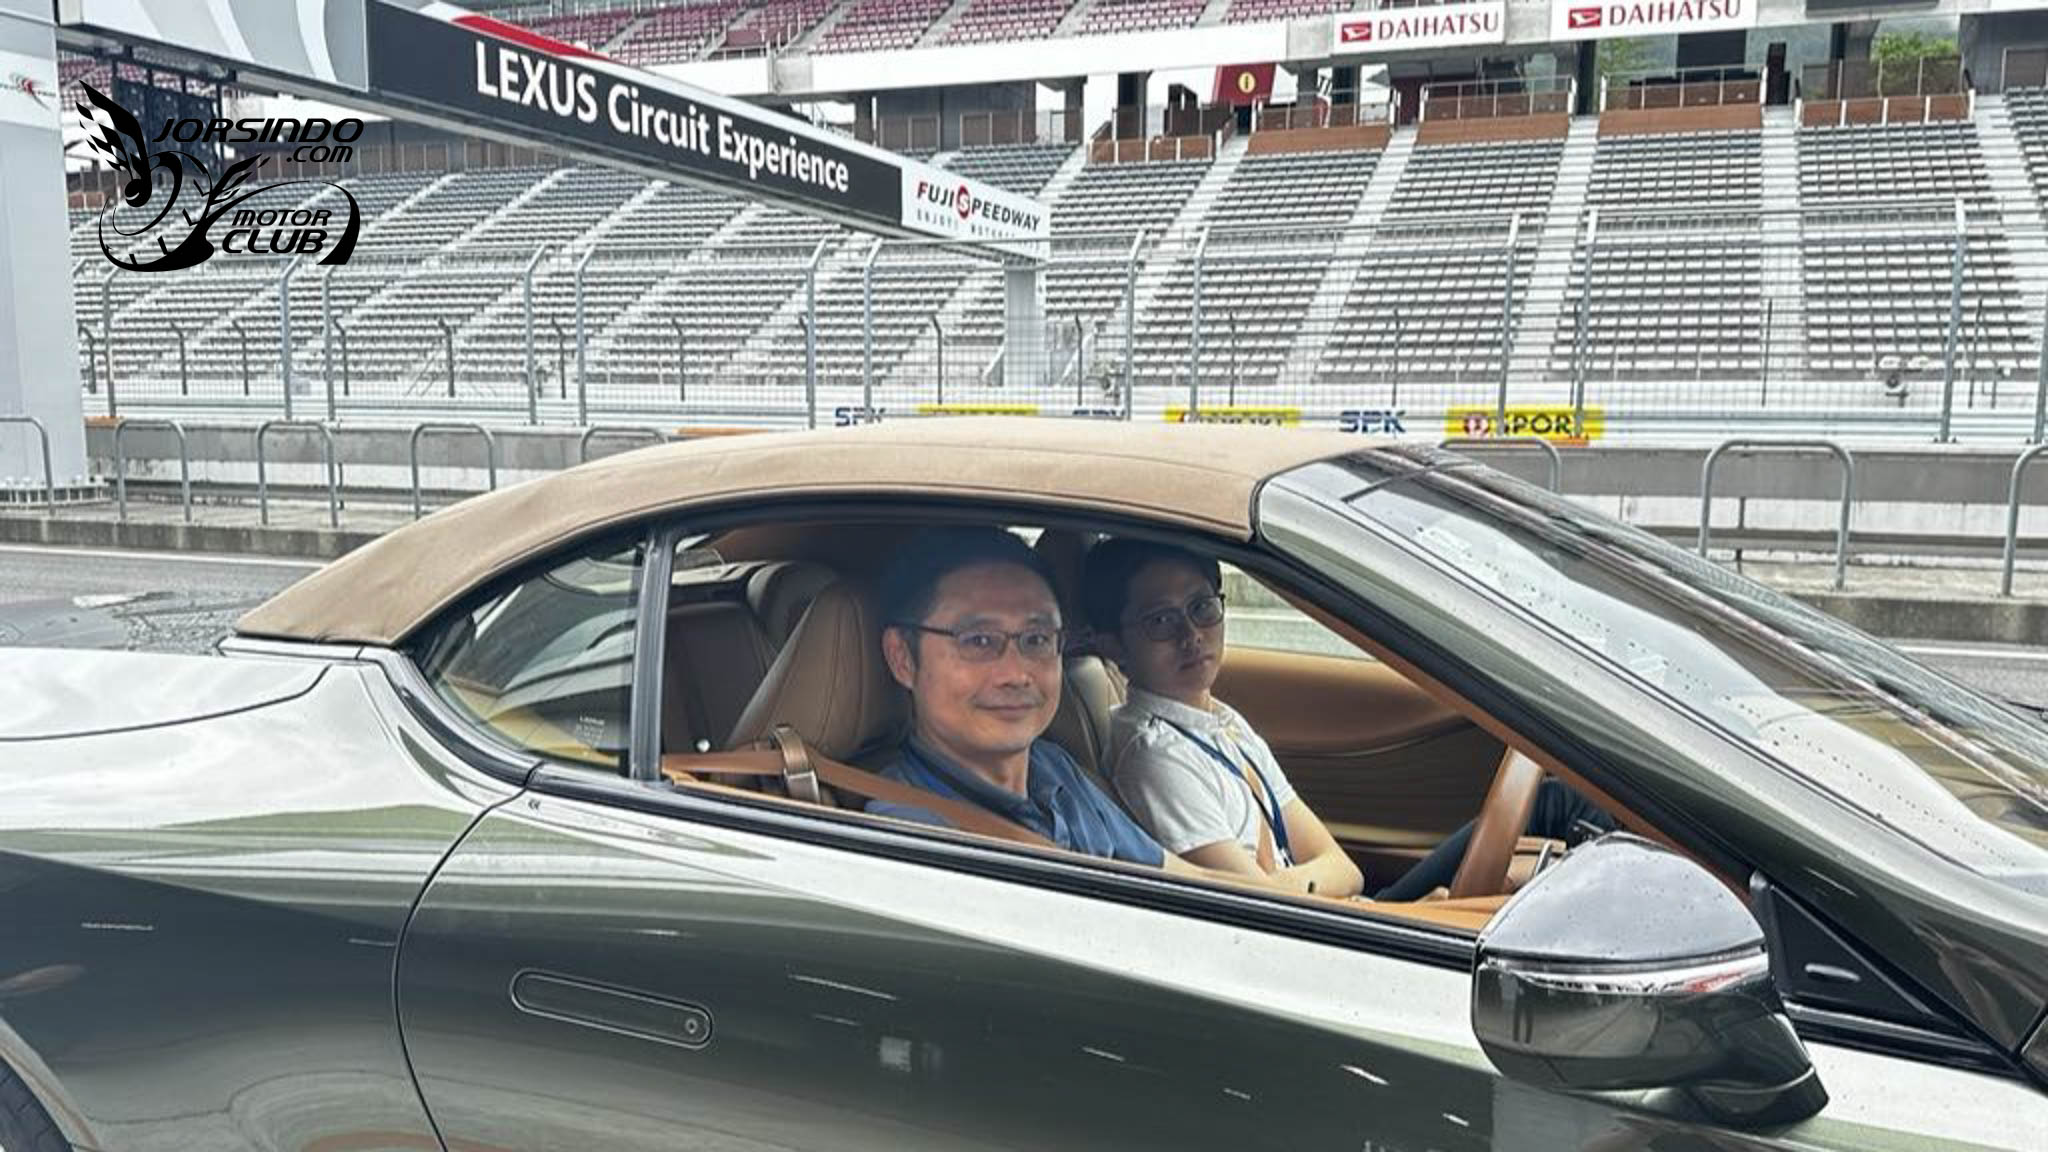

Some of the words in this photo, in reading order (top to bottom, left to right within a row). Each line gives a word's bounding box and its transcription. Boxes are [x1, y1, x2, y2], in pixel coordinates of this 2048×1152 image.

[1378, 11, 1498, 41] DAIHATSU
[1609, 0, 1741, 26] DAIHATSU
[475, 41, 598, 123] LEXUS
[607, 84, 711, 155] Circuit
[717, 116, 850, 193] Experience
[917, 181, 955, 208] FUJI
[1339, 410, 1407, 434] SPK
